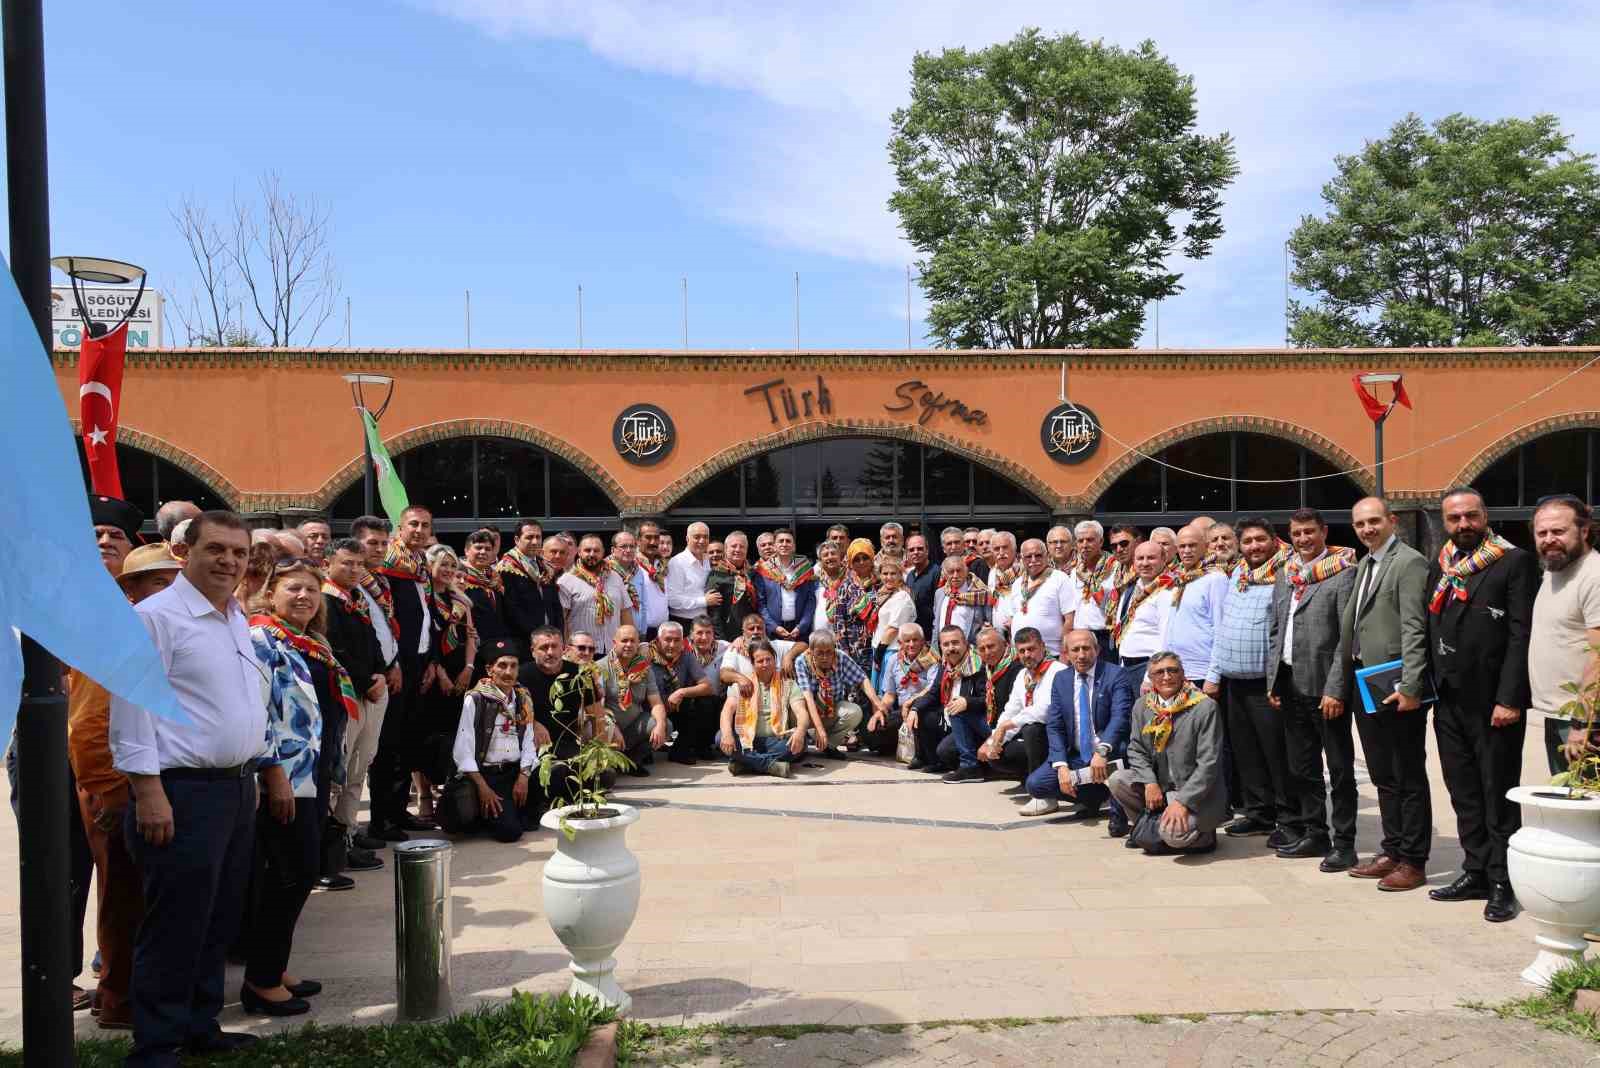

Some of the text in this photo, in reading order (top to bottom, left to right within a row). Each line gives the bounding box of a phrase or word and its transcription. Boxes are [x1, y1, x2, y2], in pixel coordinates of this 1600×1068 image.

[87, 294, 135, 306] SÖĞÜT
[71, 307, 151, 319] BLEDİYSİ
[743, 374, 832, 424] Türk
[622, 417, 661, 440] Türk
[1051, 416, 1089, 439] Türk
